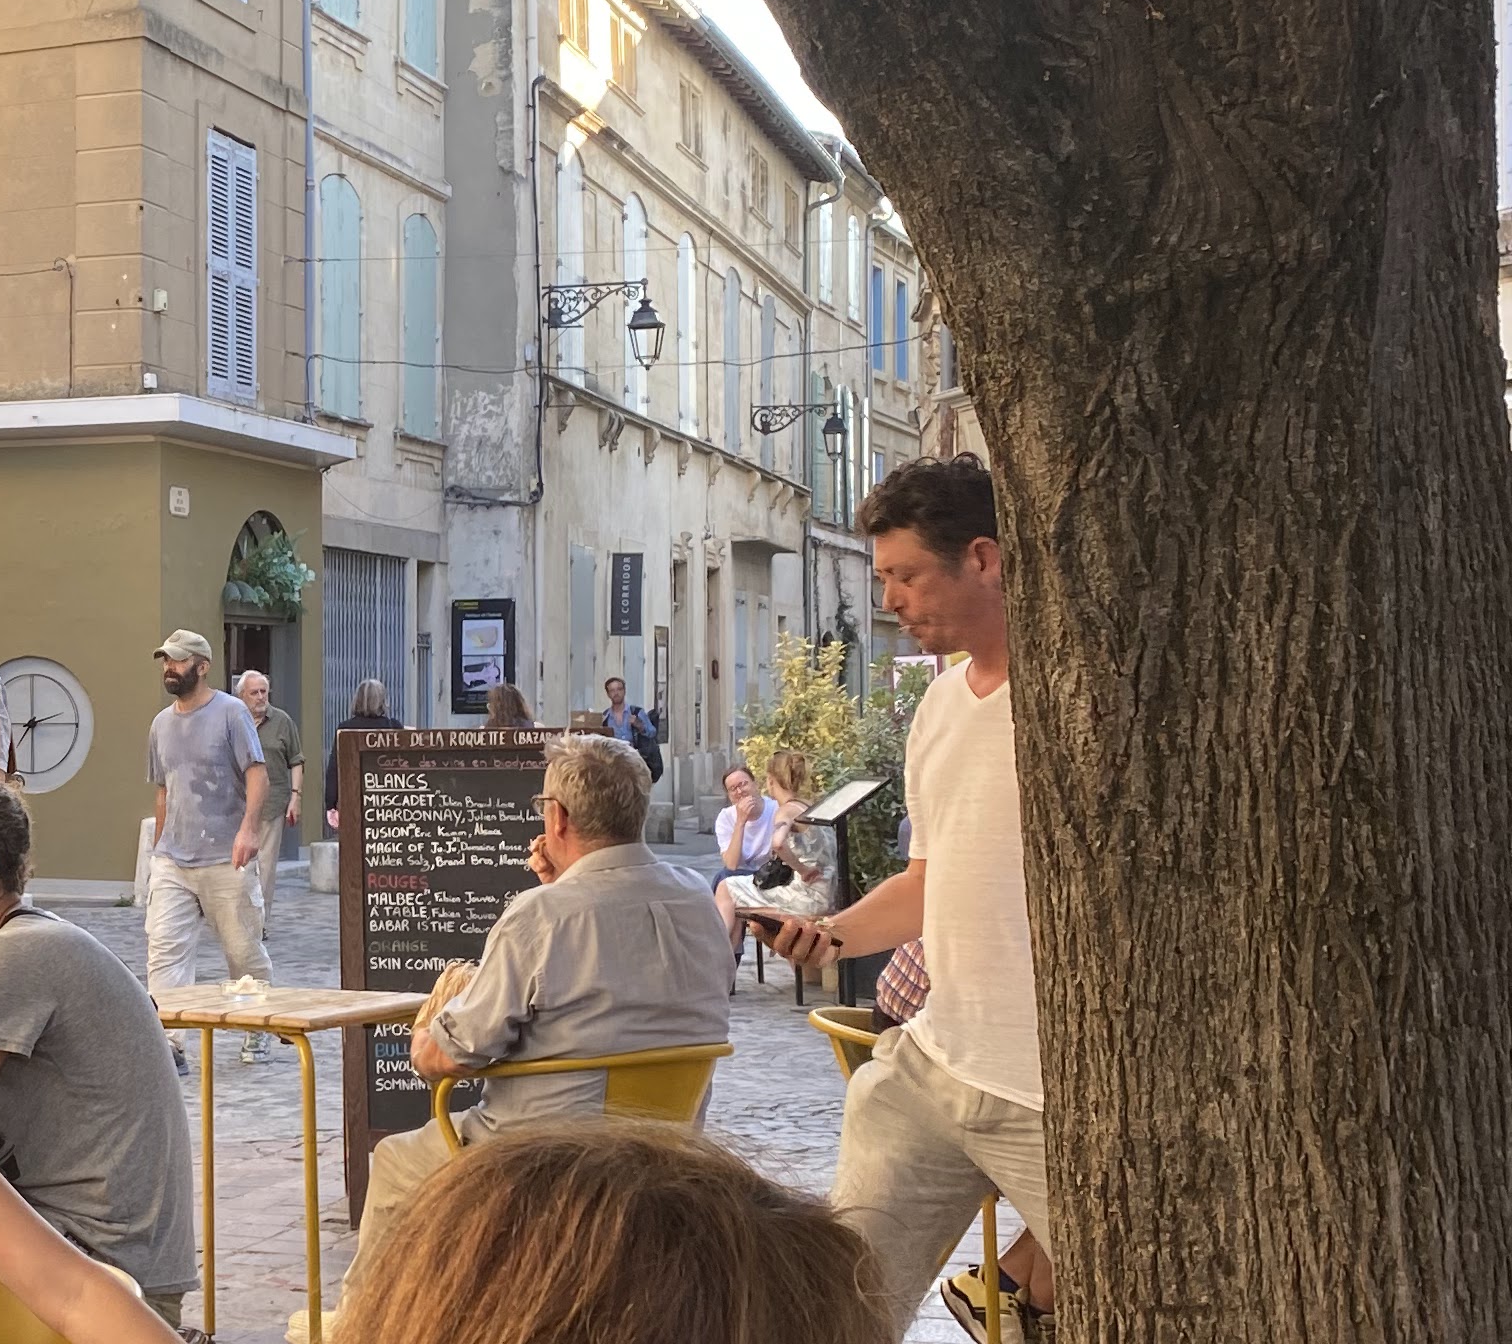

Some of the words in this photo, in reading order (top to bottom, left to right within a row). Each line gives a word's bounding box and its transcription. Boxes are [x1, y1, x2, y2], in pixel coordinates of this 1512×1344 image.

[621, 556, 632, 614] CORRIDOR
[621, 619, 629, 631] LE
[366, 732, 400, 748] CAFE
[410, 732, 425, 747] DE
[430, 731, 445, 748] LA
[449, 730, 506, 747] ROQUETTE
[377, 755, 409, 768] Carte
[419, 755, 437, 768] des
[471, 759, 488, 768] en
[364, 772, 429, 791] BLANCS
[364, 808, 466, 827] CHARDONNAY,
[467, 809, 497, 823] Julien
[365, 841, 403, 855] MAGIC
[407, 842, 425, 853] OF
[435, 852, 466, 867] Brand
[367, 873, 429, 890] ROUGES
[383, 906, 431, 921] TABLE,
[431, 907, 461, 918] Fabien
[369, 919, 410, 932] BABAR
[417, 920, 429, 931] IS
[430, 921, 456, 933] THE
[368, 940, 429, 954] ORANGE
[369, 957, 401, 970] SKIN
[373, 1023, 412, 1038] APOS
[374, 1043, 412, 1058] BULL
